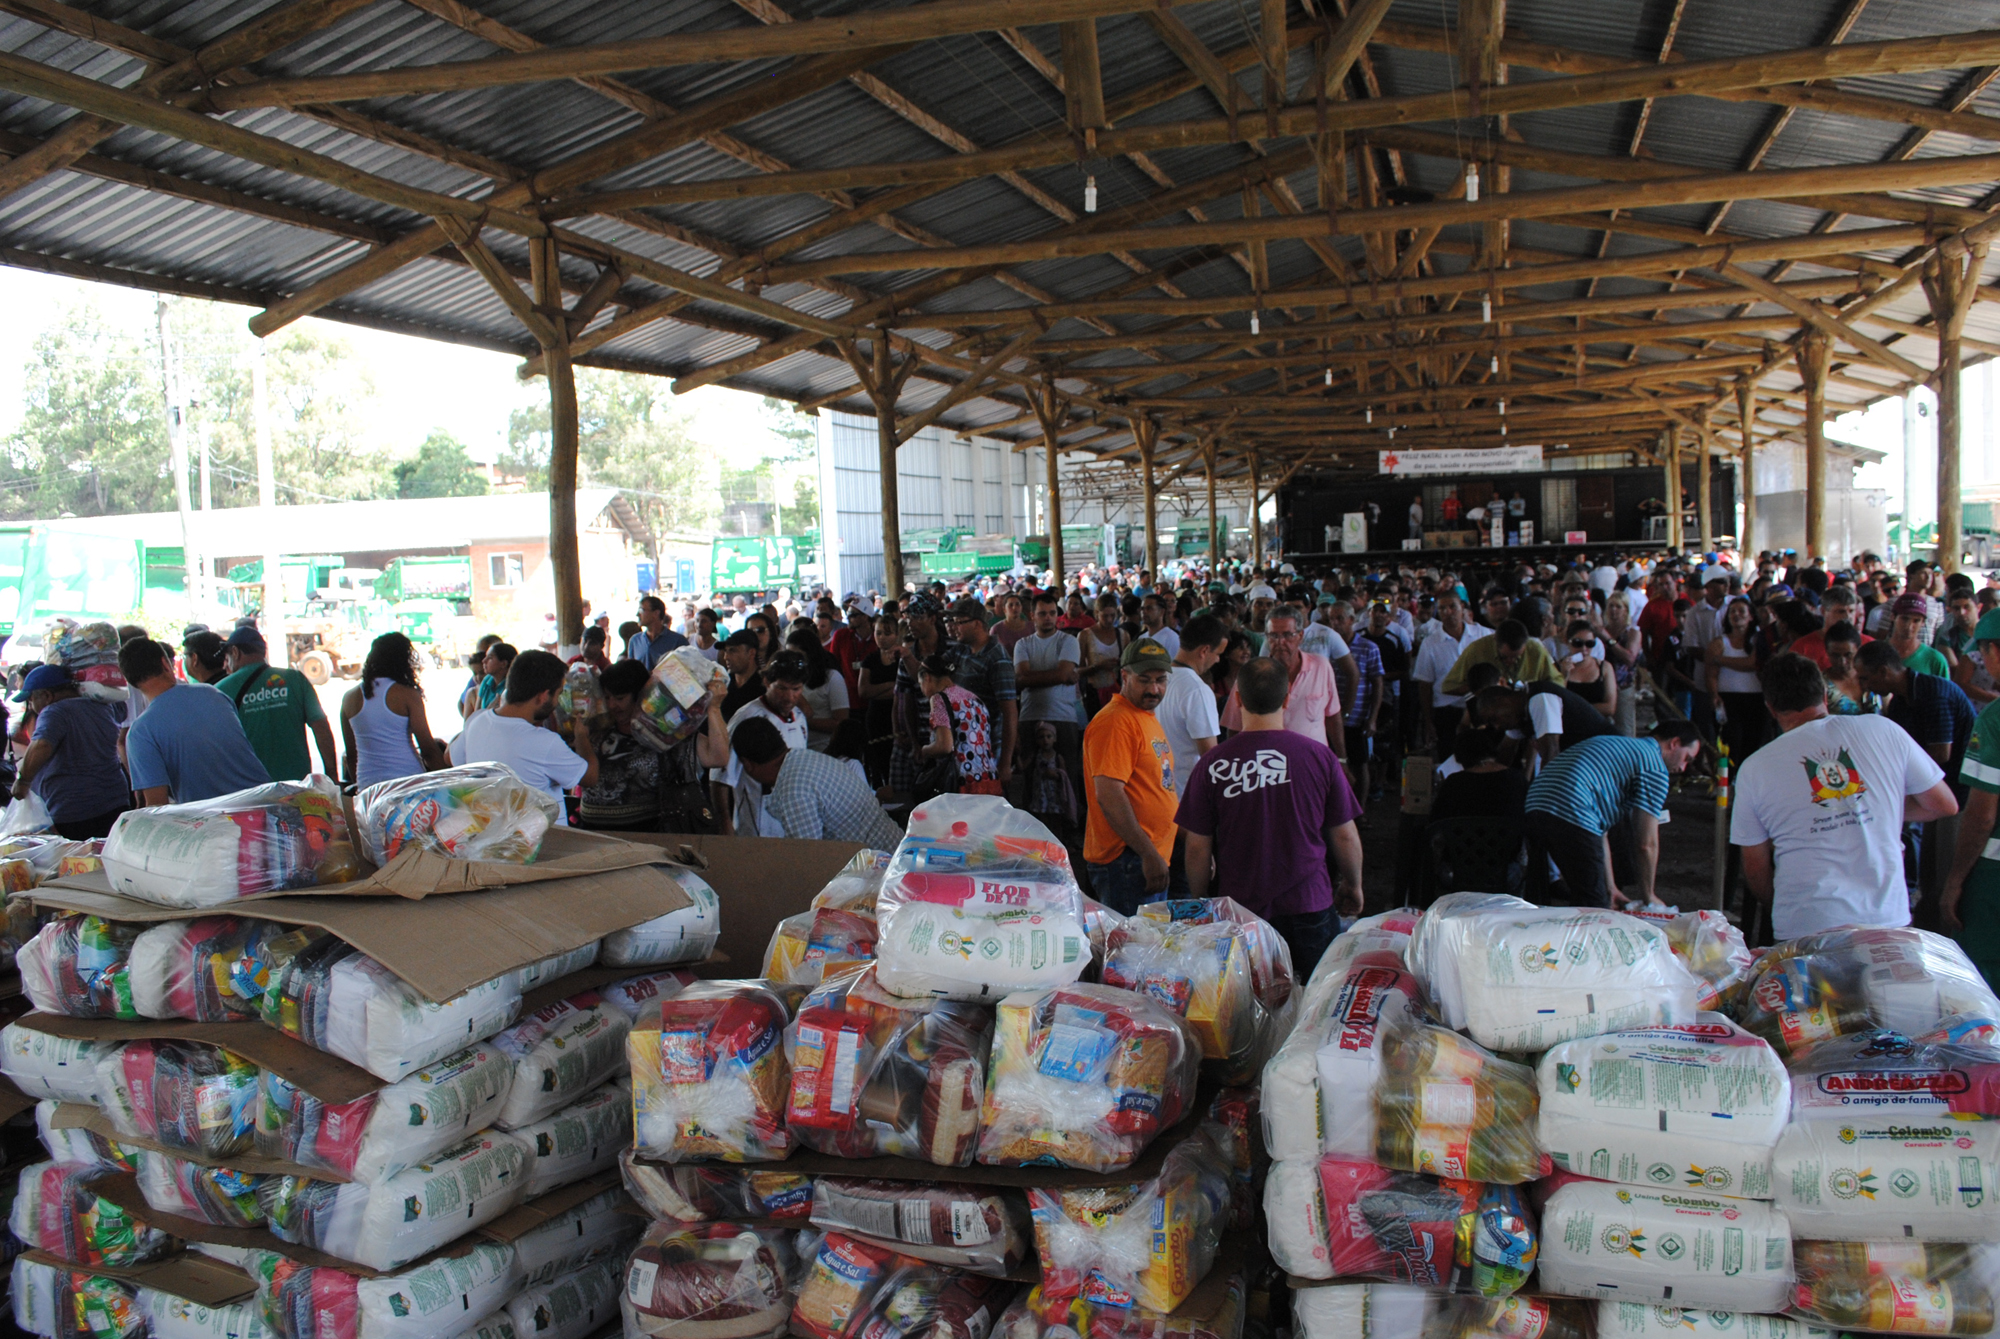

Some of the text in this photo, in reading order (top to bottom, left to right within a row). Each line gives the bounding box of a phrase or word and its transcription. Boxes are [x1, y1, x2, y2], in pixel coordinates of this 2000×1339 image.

[1421, 452, 1442, 460] NATAL
[242, 687, 289, 705] codeca
[1208, 757, 1259, 785] Rip
[1223, 769, 1292, 798] CURL
[981, 882, 1032, 899] FLOR
[985, 893, 1004, 905] DE
[1627, 1032, 1660, 1040] amigo
[1826, 1074, 1962, 1091] ANDREAZZA
[1841, 1096, 1850, 1105] O
[1853, 1096, 1889, 1106] amigo
[1891, 1096, 1906, 1104] da
[1634, 1193, 1660, 1201] Usina
[835, 1245, 857, 1262] germani
[1170, 1227, 1184, 1296] Garoto
[822, 1251, 860, 1278] Água e Sal
